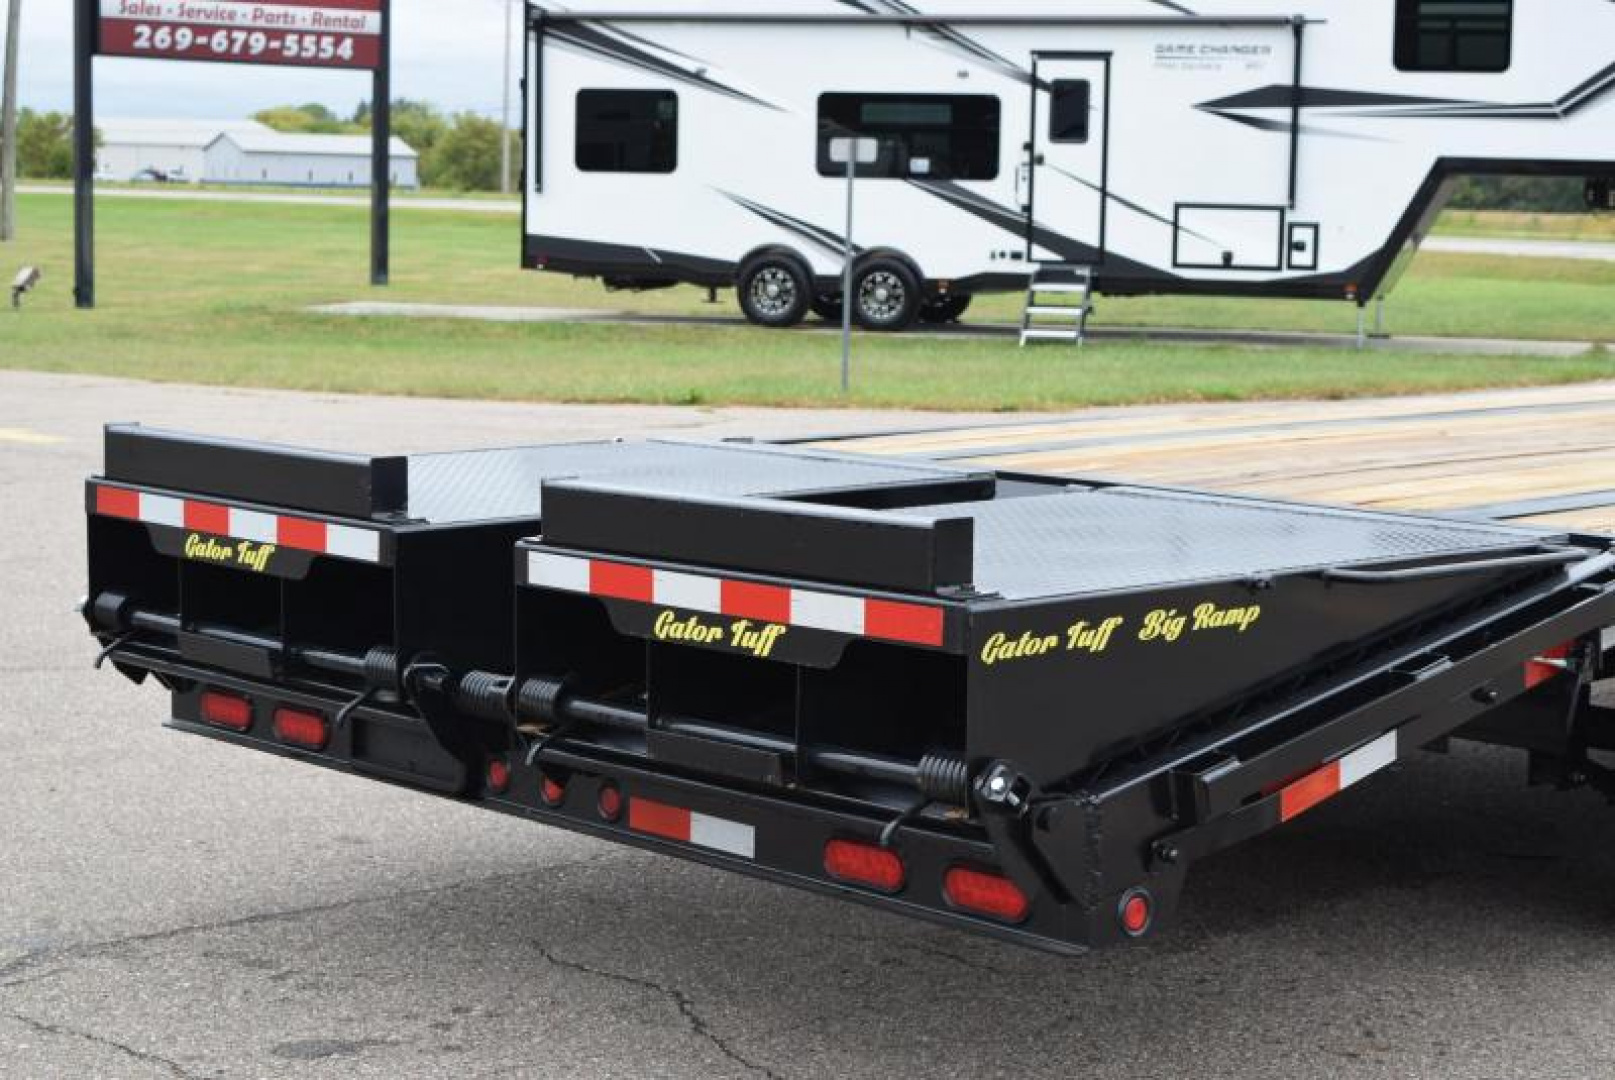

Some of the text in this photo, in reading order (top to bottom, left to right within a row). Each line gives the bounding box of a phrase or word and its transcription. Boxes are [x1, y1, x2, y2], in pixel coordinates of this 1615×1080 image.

[119, 0, 366, 29] Sales Service Parts Rental
[133, 24, 353, 60] 269-679-5554
[185, 532, 275, 571] Gator Tuff
[654, 610, 786, 657] Gator Tuff
[981, 602, 1261, 664] Gator Tuff Big Ramp
